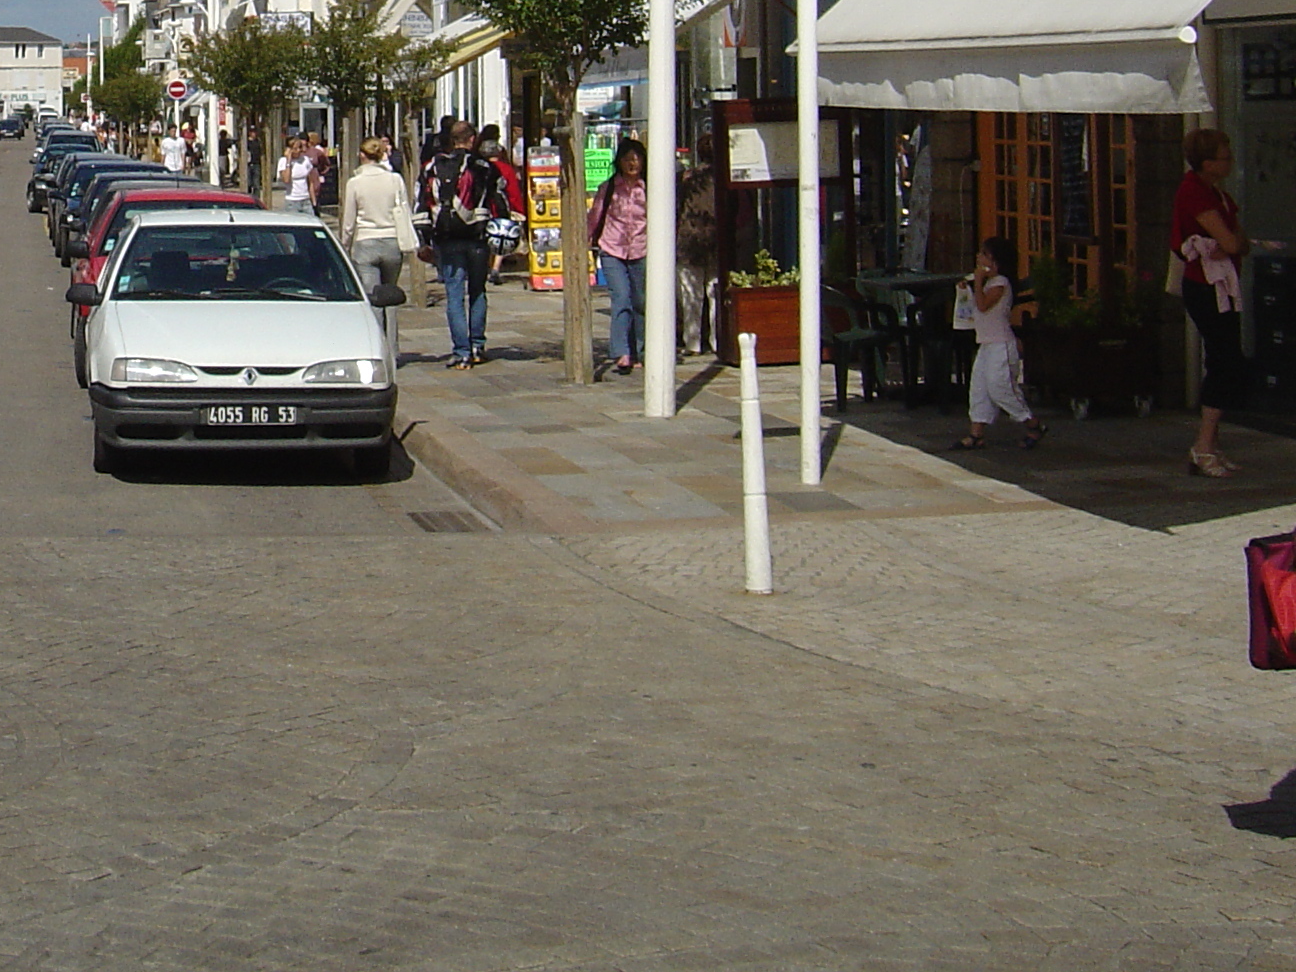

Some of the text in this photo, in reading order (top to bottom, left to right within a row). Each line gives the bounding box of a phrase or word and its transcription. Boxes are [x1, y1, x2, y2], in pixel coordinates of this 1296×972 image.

[209, 406, 296, 424] 4055 RG 53
